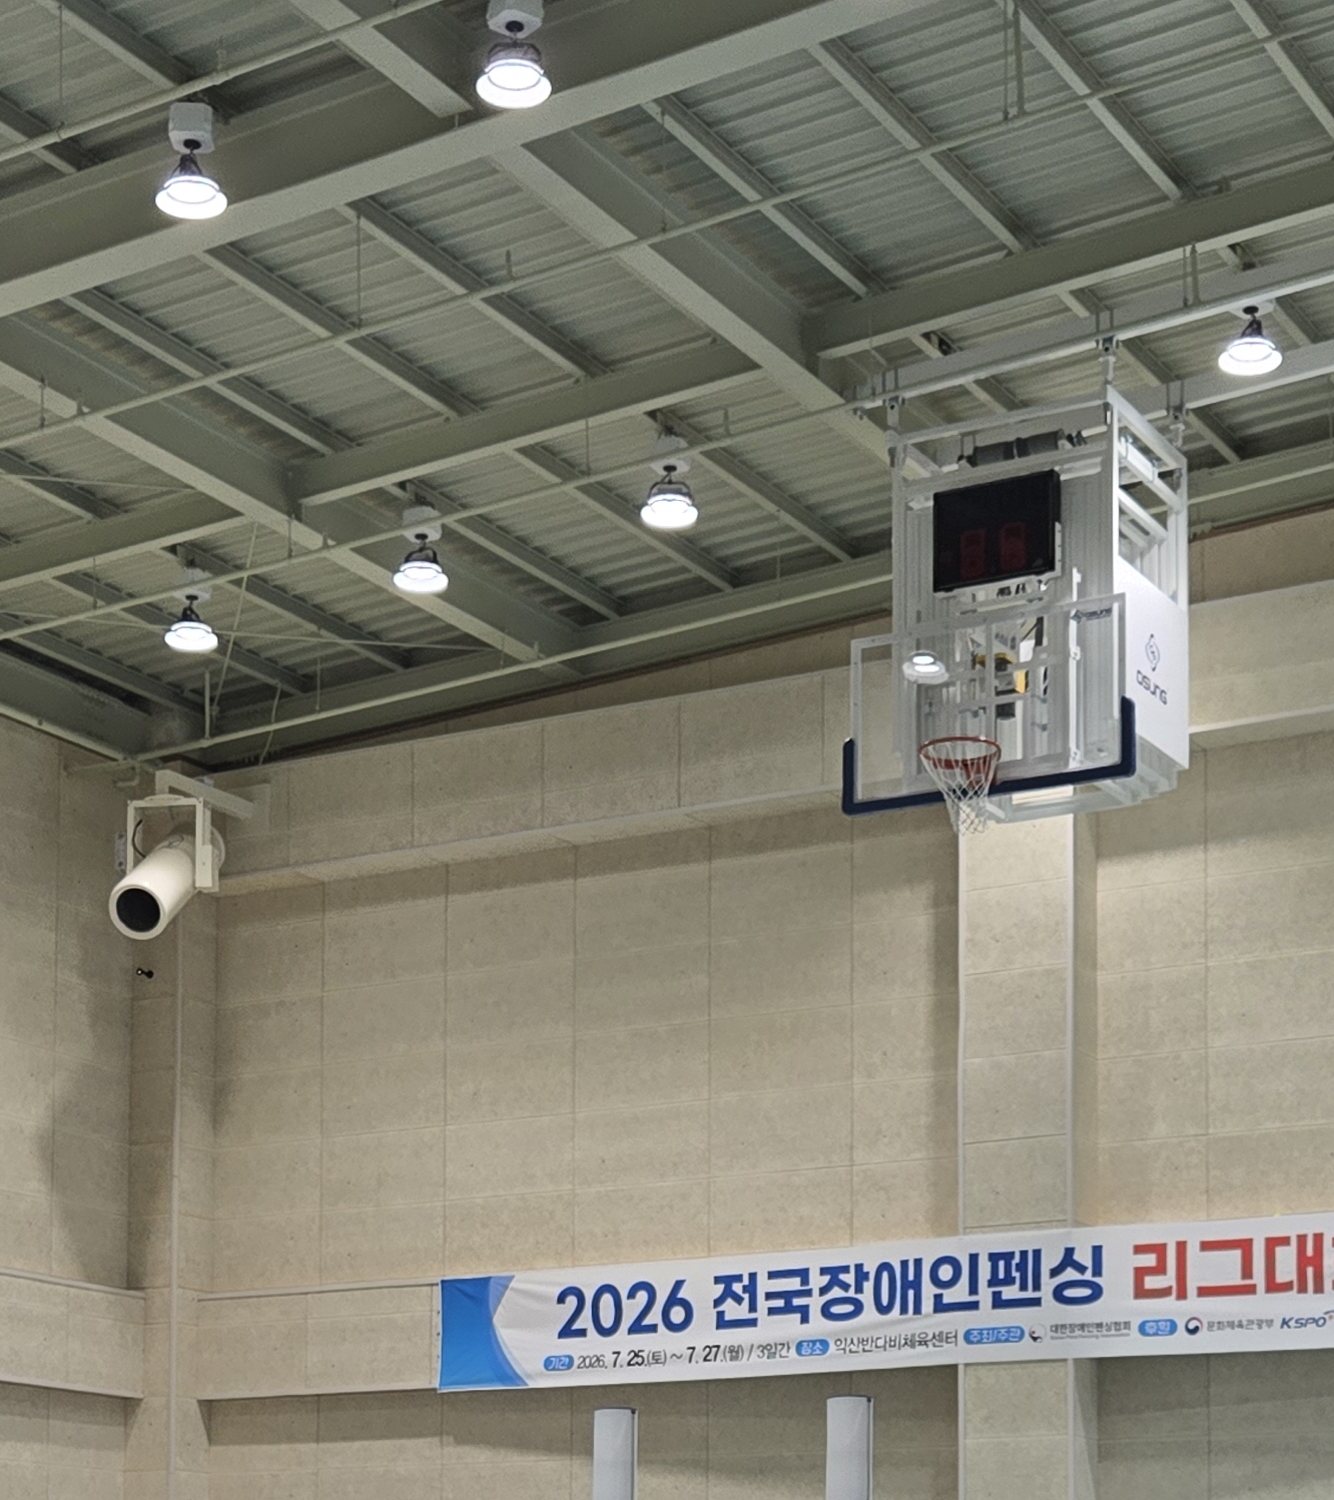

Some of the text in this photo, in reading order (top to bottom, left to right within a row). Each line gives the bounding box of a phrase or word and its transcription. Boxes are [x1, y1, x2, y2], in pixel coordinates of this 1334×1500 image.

[556, 1279, 695, 1339] 2026
[712, 1243, 1105, 1331] 전국장애인펜싱
[1279, 1316, 1327, 1330] KSPO
[800, 1328, 959, 1355] 장소 익산반다비체육센터
[969, 1326, 1022, 1343] 주최/주관
[545, 1356, 569, 1371] 기간
[577, 1354, 608, 1370] 2026.
